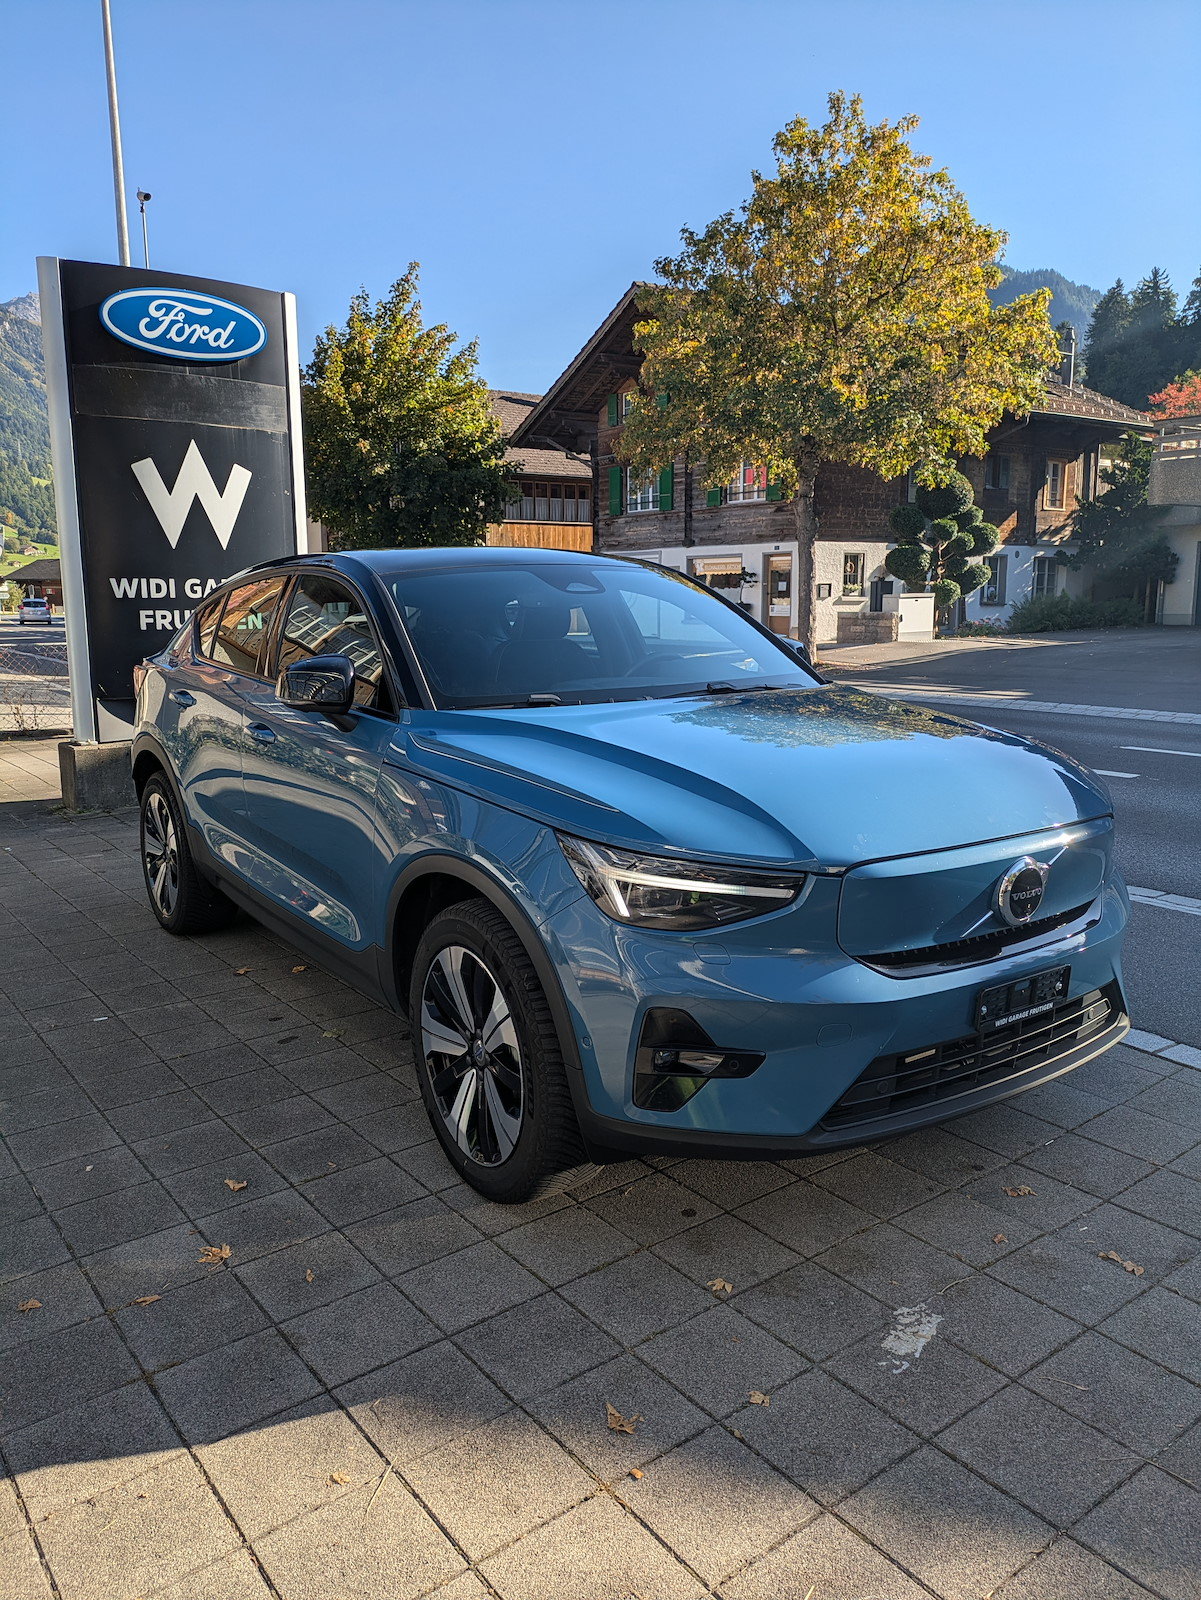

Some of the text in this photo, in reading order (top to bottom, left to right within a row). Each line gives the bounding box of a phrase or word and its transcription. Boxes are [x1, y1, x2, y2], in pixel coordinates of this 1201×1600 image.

[139, 299, 236, 349] Ford
[131, 438, 253, 551] W
[109, 577, 228, 599] WIDI GA
[1011, 887, 1042, 901] VOLVO
[995, 1002, 1054, 1027] WIDI GARAGE FRUTIGEN
